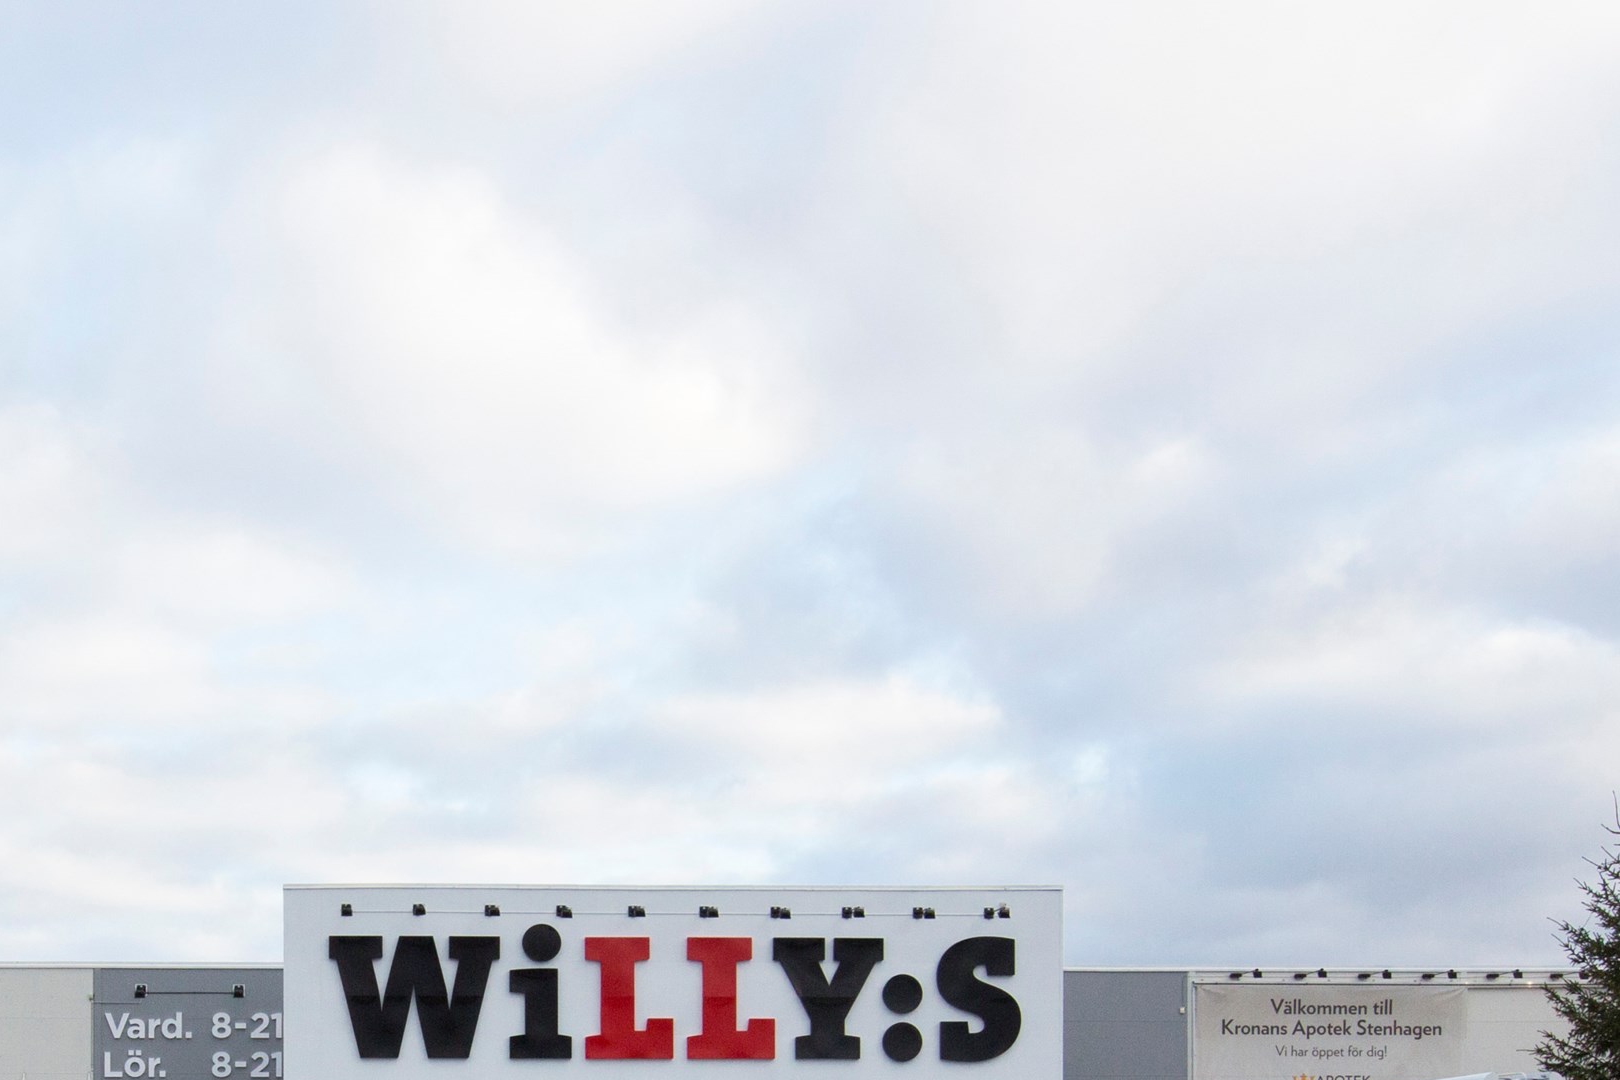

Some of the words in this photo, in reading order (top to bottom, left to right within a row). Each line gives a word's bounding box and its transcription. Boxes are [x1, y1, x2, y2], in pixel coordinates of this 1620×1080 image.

[1271, 998, 1368, 1015] Välkommen
[1373, 999, 1393, 1015] till
[105, 1012, 192, 1039] Vard.
[211, 1012, 283, 1039] 8-21
[1221, 1018, 1288, 1035] Kronans
[1292, 1019, 1351, 1039] Apotek
[1356, 1019, 1442, 1040] Stenhagen
[1275, 1045, 1288, 1057] Vi
[1290, 1045, 1308, 1057] har
[1312, 1045, 1345, 1060] öppet
[1347, 1045, 1363, 1057] för
[1366, 1045, 1388, 1060] dig!
[104, 1050, 166, 1078] Lör.
[211, 1051, 283, 1078] 8-21
